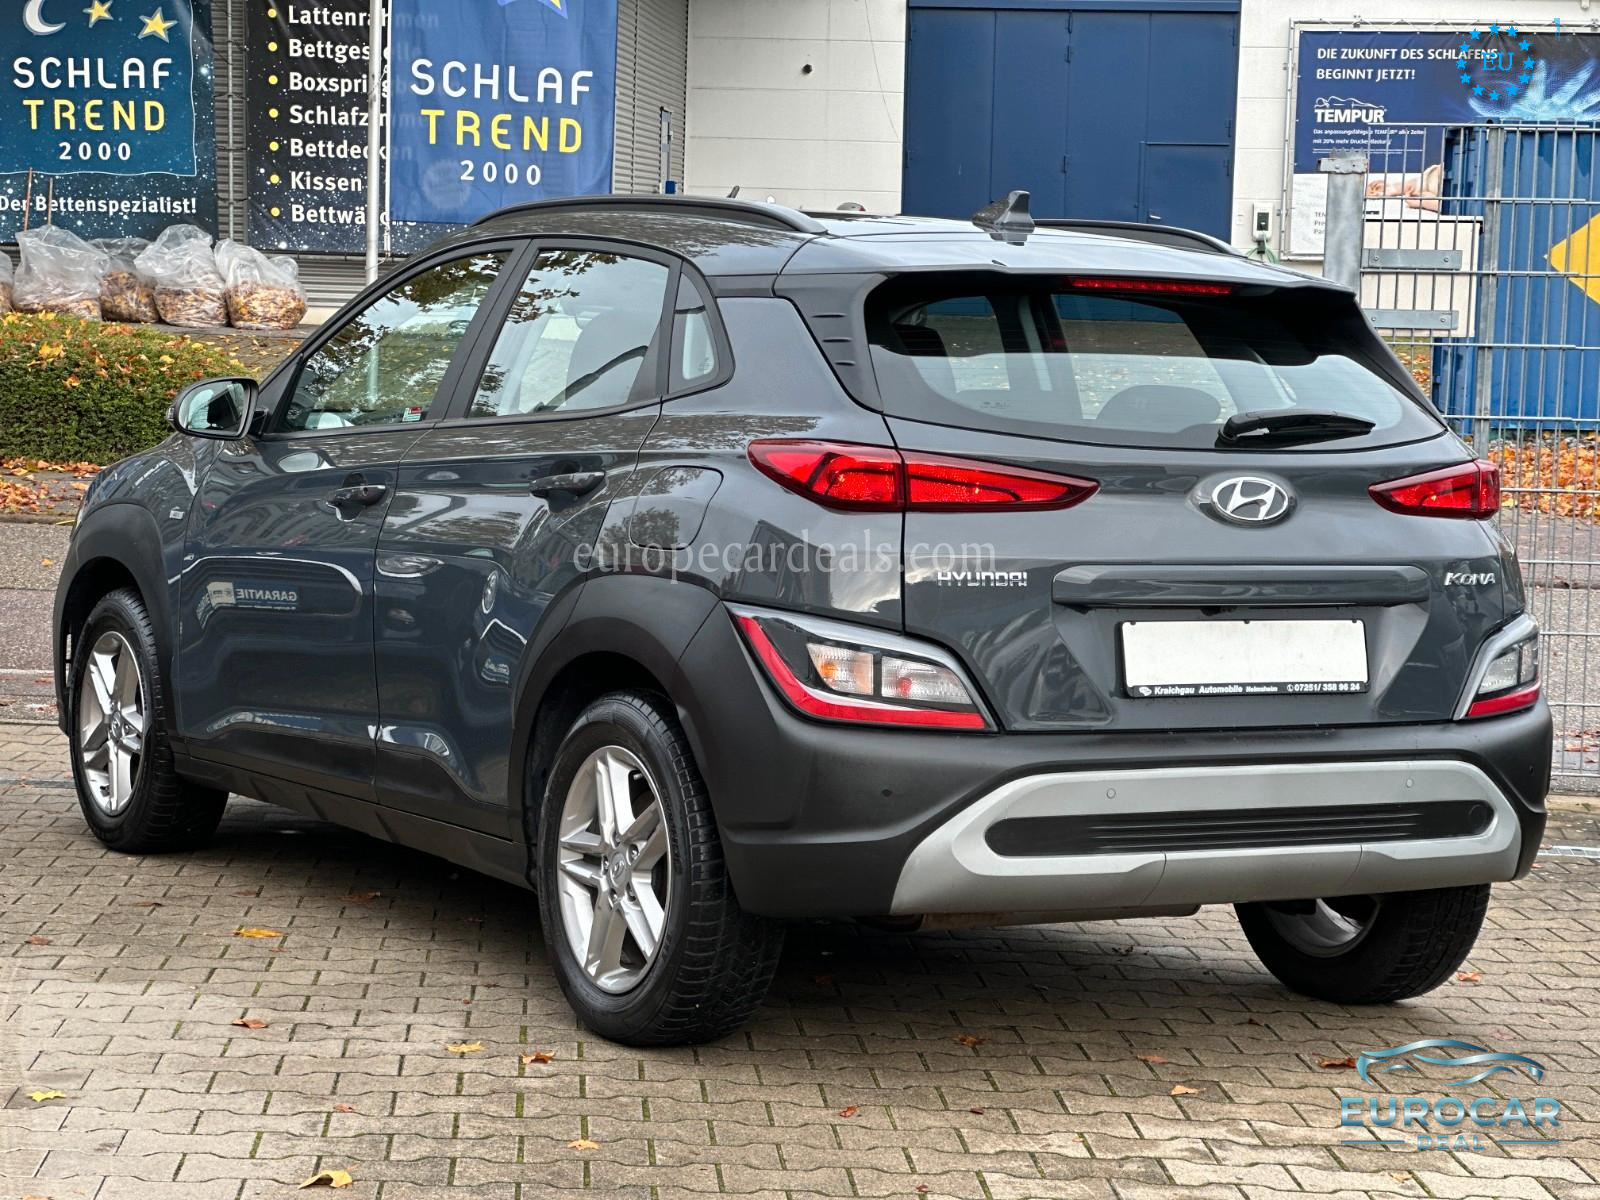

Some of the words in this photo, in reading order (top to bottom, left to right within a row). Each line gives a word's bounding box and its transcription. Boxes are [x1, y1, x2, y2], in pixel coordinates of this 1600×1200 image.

[1317, 48, 1337, 59] DIE
[1341, 48, 1397, 60] ZUKUNFT
[1401, 48, 1424, 60] DES
[1428, 49, 1498, 61] SCHLAFENS
[13, 57, 172, 88] SCHLAF
[410, 58, 593, 106] SCHLAF
[1316, 69, 1374, 80] BEGINNT
[1376, 69, 1416, 82] JETZT!
[23, 99, 165, 131] TREND
[1314, 109, 1385, 123] TEMPUR
[420, 109, 582, 153] TREND
[59, 142, 131, 161] 2000
[290, 171, 362, 192] Kissen
[460, 160, 541, 186] 2000
[0, 195, 29, 211] Der
[35, 194, 197, 214] Bettenspezialist!
[937, 571, 1028, 586] HYUNDAI
[1444, 572, 1496, 586] KONA
[1154, 686, 1195, 696] Kraichgau
[1199, 684, 1243, 694] Automobile
[1350, 683, 1360, 691] 24
